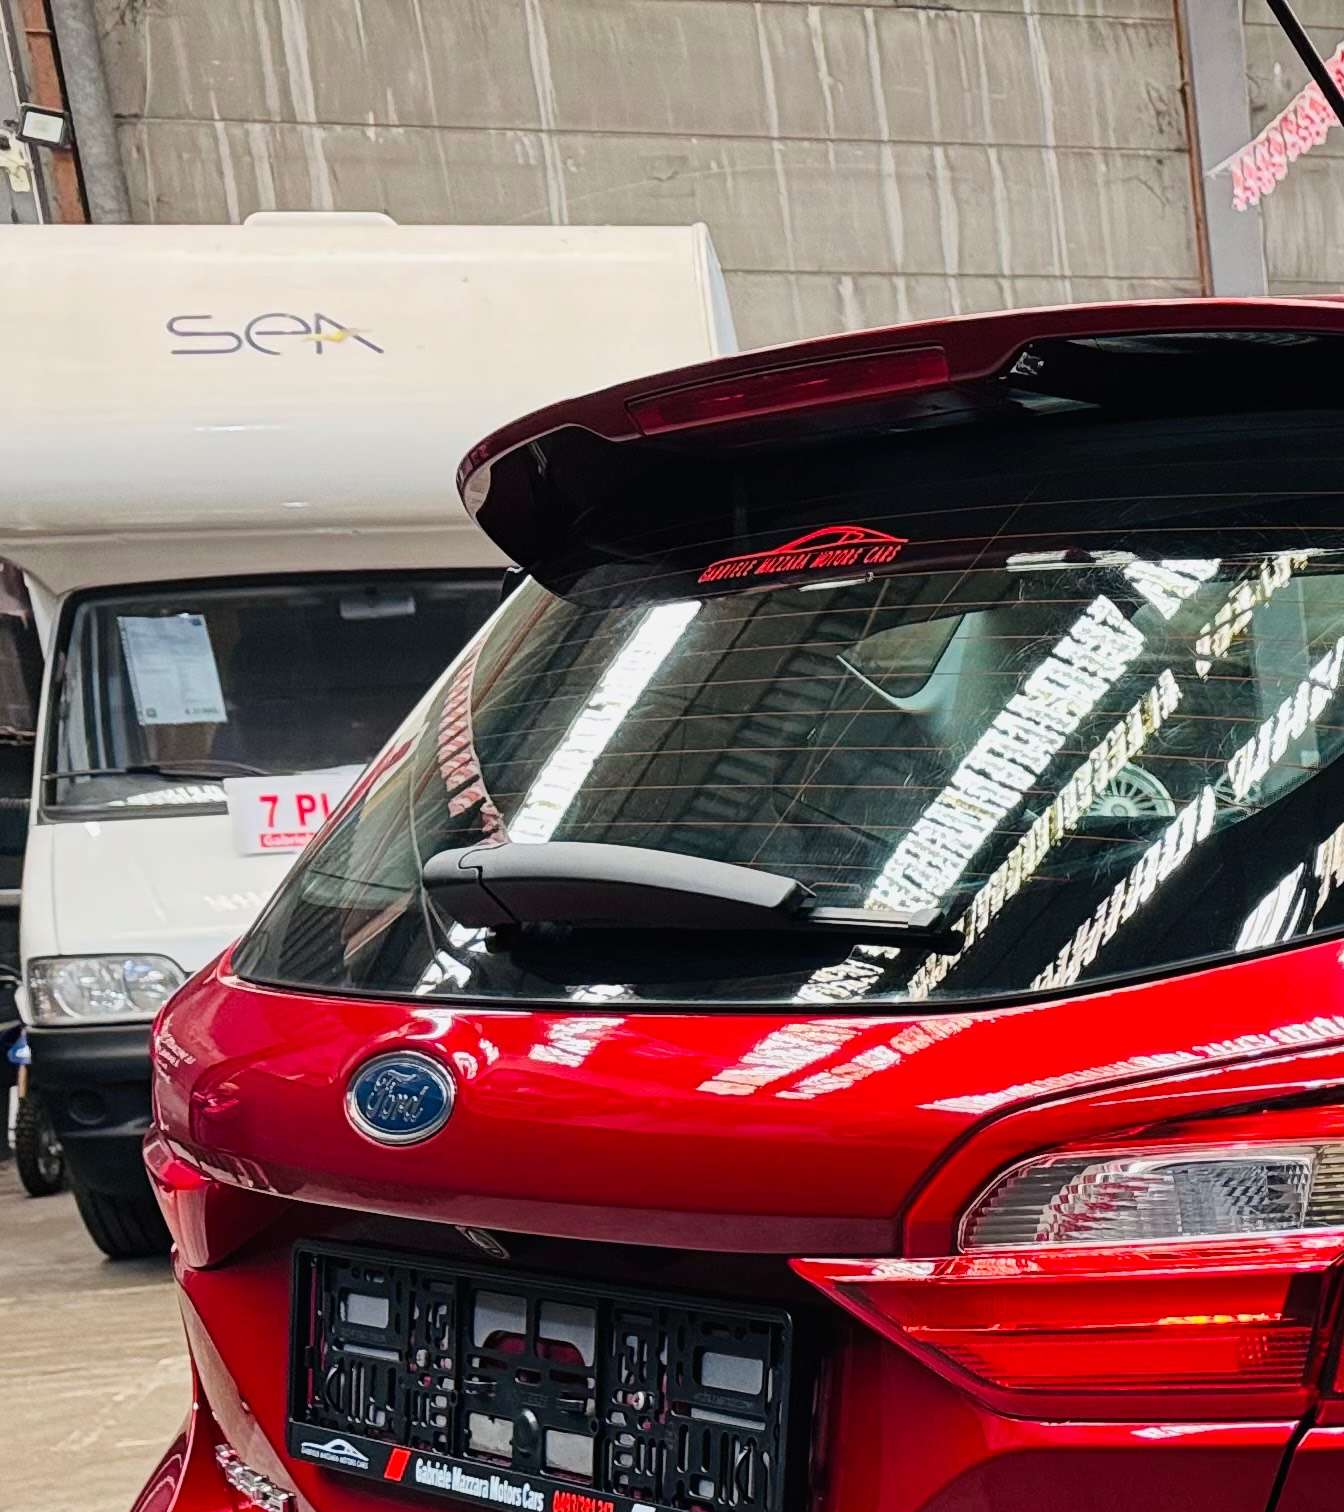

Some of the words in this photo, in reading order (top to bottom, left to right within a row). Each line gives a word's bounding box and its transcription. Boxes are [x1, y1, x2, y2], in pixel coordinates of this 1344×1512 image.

[810, 547, 863, 568] MOTORS
[863, 545, 901, 564] CARS
[259, 794, 279, 829] 7
[365, 1069, 430, 1122] Ford
[415, 1458, 452, 1489] Gabriele
[452, 1466, 489, 1499] Mazzara
[489, 1474, 522, 1507] Motors
[522, 1483, 545, 1512] Cars
